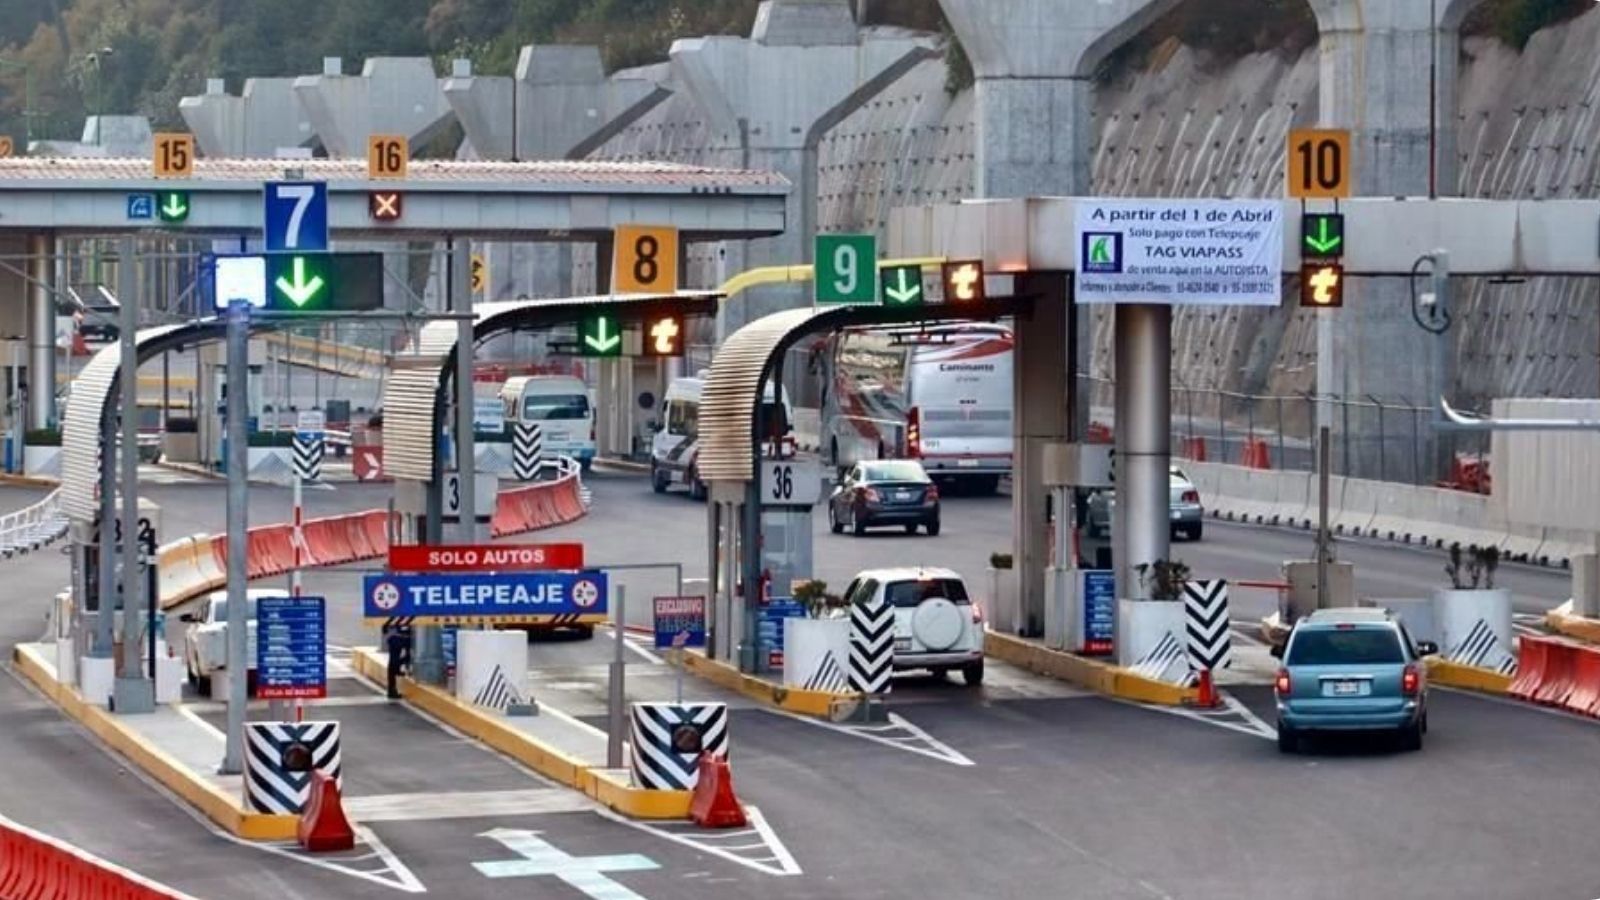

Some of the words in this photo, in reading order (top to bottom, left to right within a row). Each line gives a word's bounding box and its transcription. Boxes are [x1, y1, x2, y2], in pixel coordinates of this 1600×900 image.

[160, 140, 188, 172] 15
[374, 140, 401, 173] 16
[1297, 139, 1341, 190] 10
[277, 185, 315, 248] 7
[1092, 207, 1105, 220] A
[1110, 208, 1156, 223] partir
[1160, 208, 1186, 221] del
[1194, 209, 1199, 221] 1
[1206, 209, 1227, 222] de
[1232, 209, 1272, 222] Abril
[1129, 227, 1152, 238] Solo
[1155, 229, 1182, 241] pago
[1185, 229, 1206, 239] con
[633, 235, 659, 285] 8
[1144, 245, 1177, 258] TAG
[1180, 246, 1244, 259] VIAPASS
[833, 243, 858, 295] 9
[1141, 265, 1166, 275] venta
[939, 363, 995, 373] Caminante
[772, 465, 793, 500] 36
[428, 550, 478, 566] SOLO
[483, 549, 545, 565] AUTOS
[409, 583, 564, 606] TELEPEAJE
[656, 599, 703, 614] EXCLUSIVO
